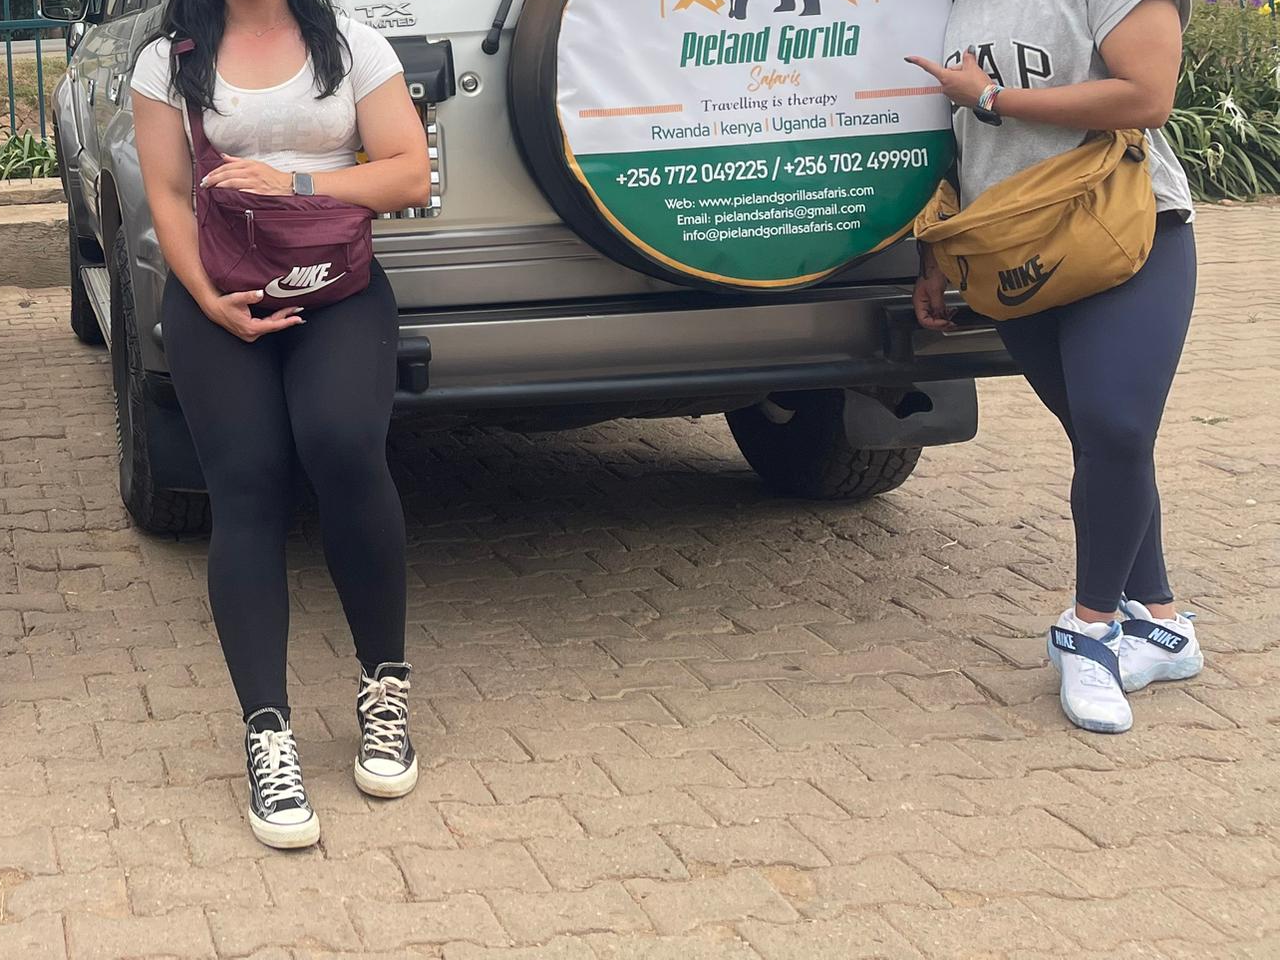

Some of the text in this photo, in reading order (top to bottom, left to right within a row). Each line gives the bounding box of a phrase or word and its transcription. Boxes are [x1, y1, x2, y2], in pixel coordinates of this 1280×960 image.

[354, 2, 412, 18] TX
[680, 21, 861, 67] Pieland Gorilla
[747, 65, 801, 92] Safaris
[701, 93, 838, 112] Travelling is therapy
[651, 110, 899, 140] Rwanda kenya Uganda Tanzania
[616, 167, 661, 188] +256
[664, 163, 697, 185] 772
[701, 160, 768, 183] 049225
[783, 155, 827, 176] +256
[829, 153, 862, 174] 702
[866, 148, 928, 170] 499901
[665, 186, 874, 209] Web: www.pielandgorillasafaris.com
[677, 202, 866, 226] Email: pielandsafaris@gmail.com
[683, 219, 861, 242] info@pielandgorillasafaris.com
[280, 262, 332, 287] NIKE
[998, 254, 1044, 292] NIKE
[1054, 630, 1076, 650] NIKE
[1148, 627, 1182, 650] NIKE
